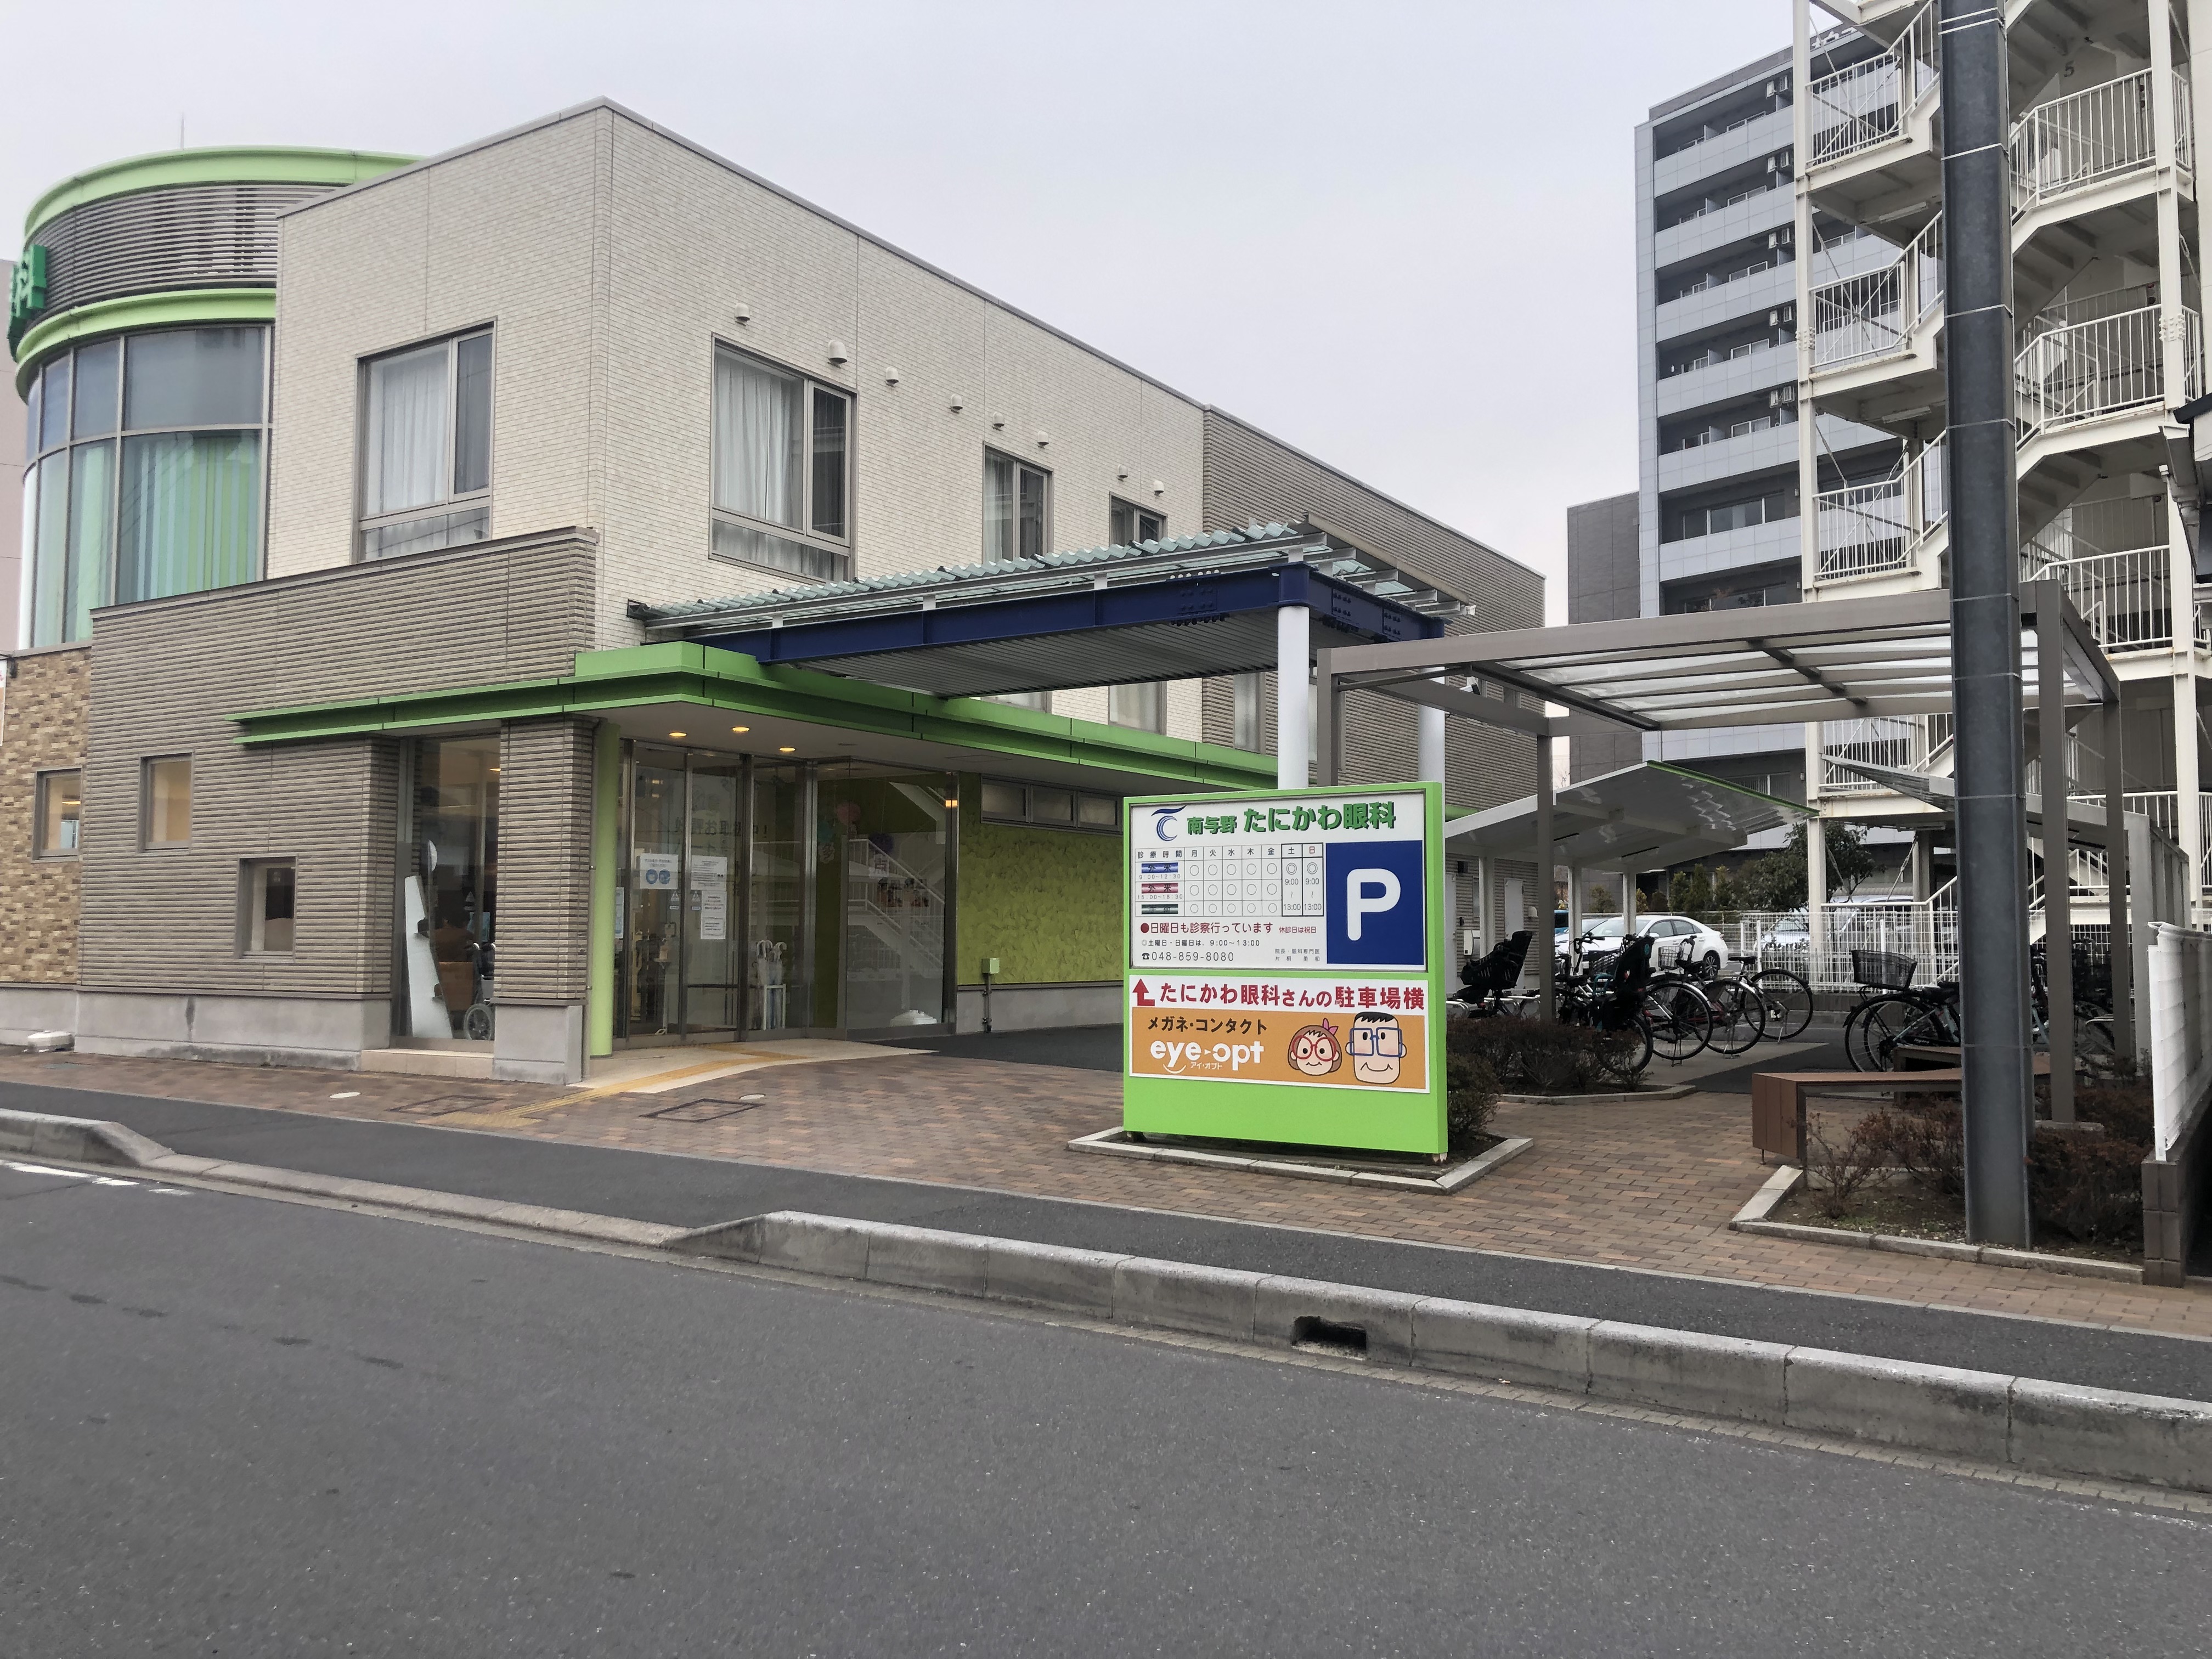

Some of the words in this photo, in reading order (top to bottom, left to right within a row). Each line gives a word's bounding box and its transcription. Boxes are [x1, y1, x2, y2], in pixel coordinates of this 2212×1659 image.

[2064, 60, 2074, 77] 5
[1187, 816, 1237, 835] 南与野
[1244, 802, 1396, 832] たにかわ眼科
[1347, 868, 1401, 941] P
[1152, 951, 1234, 961] 048-859-8080
[1160, 983, 1425, 1010] たにかわ眼科さんの駐車場横
[1148, 1015, 1267, 1035] メガネ・コンタクト
